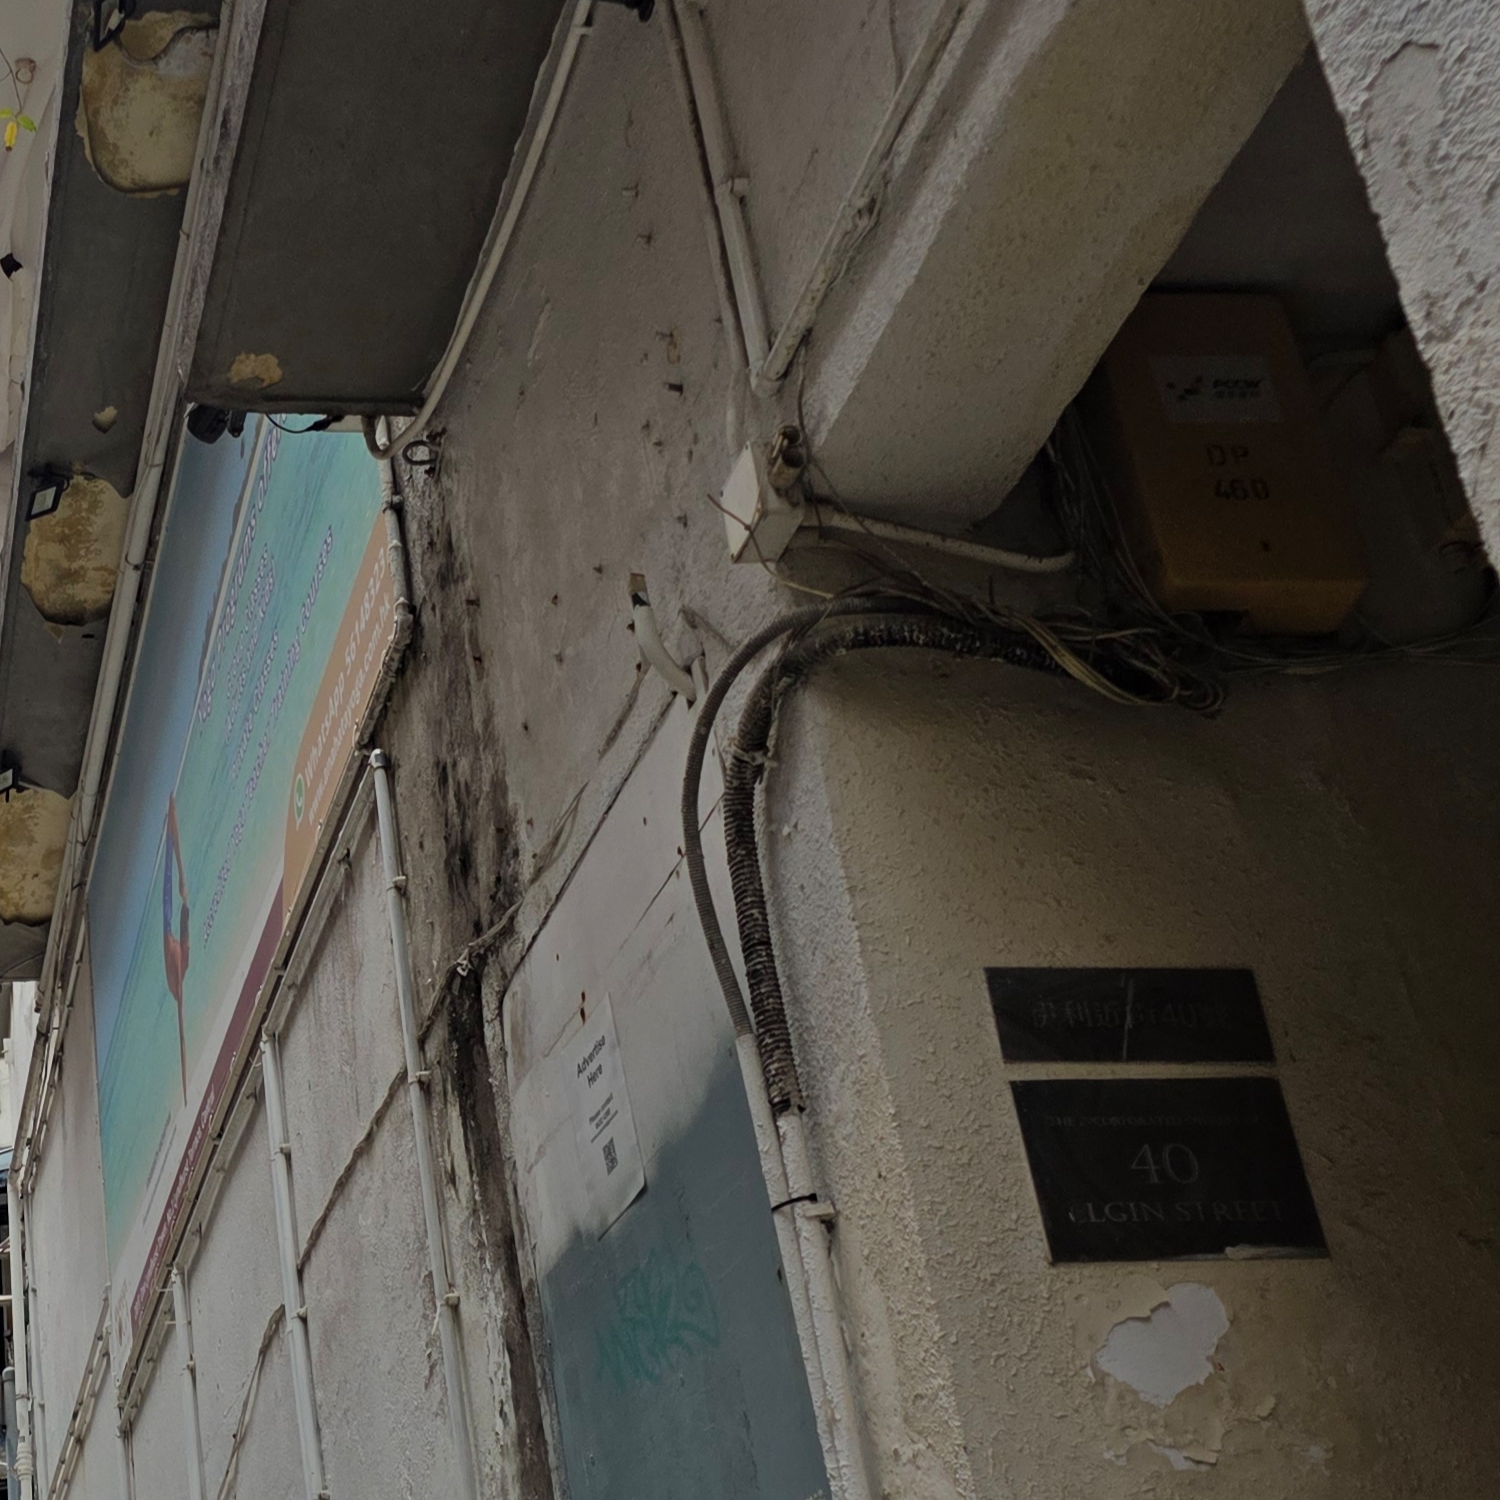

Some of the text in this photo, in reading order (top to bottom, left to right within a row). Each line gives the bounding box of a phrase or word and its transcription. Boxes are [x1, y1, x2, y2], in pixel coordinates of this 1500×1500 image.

[217, 504, 257, 668] Programs
[269, 630, 301, 724] Training
[299, 524, 333, 636] Courses
[304, 546, 387, 788] WhatsApp 56148323
[577, 1034, 606, 1079] Advertise
[587, 1063, 603, 1089] Here
[1128, 1142, 1200, 1185] 40
[1175, 1200, 1285, 1223] STREET
